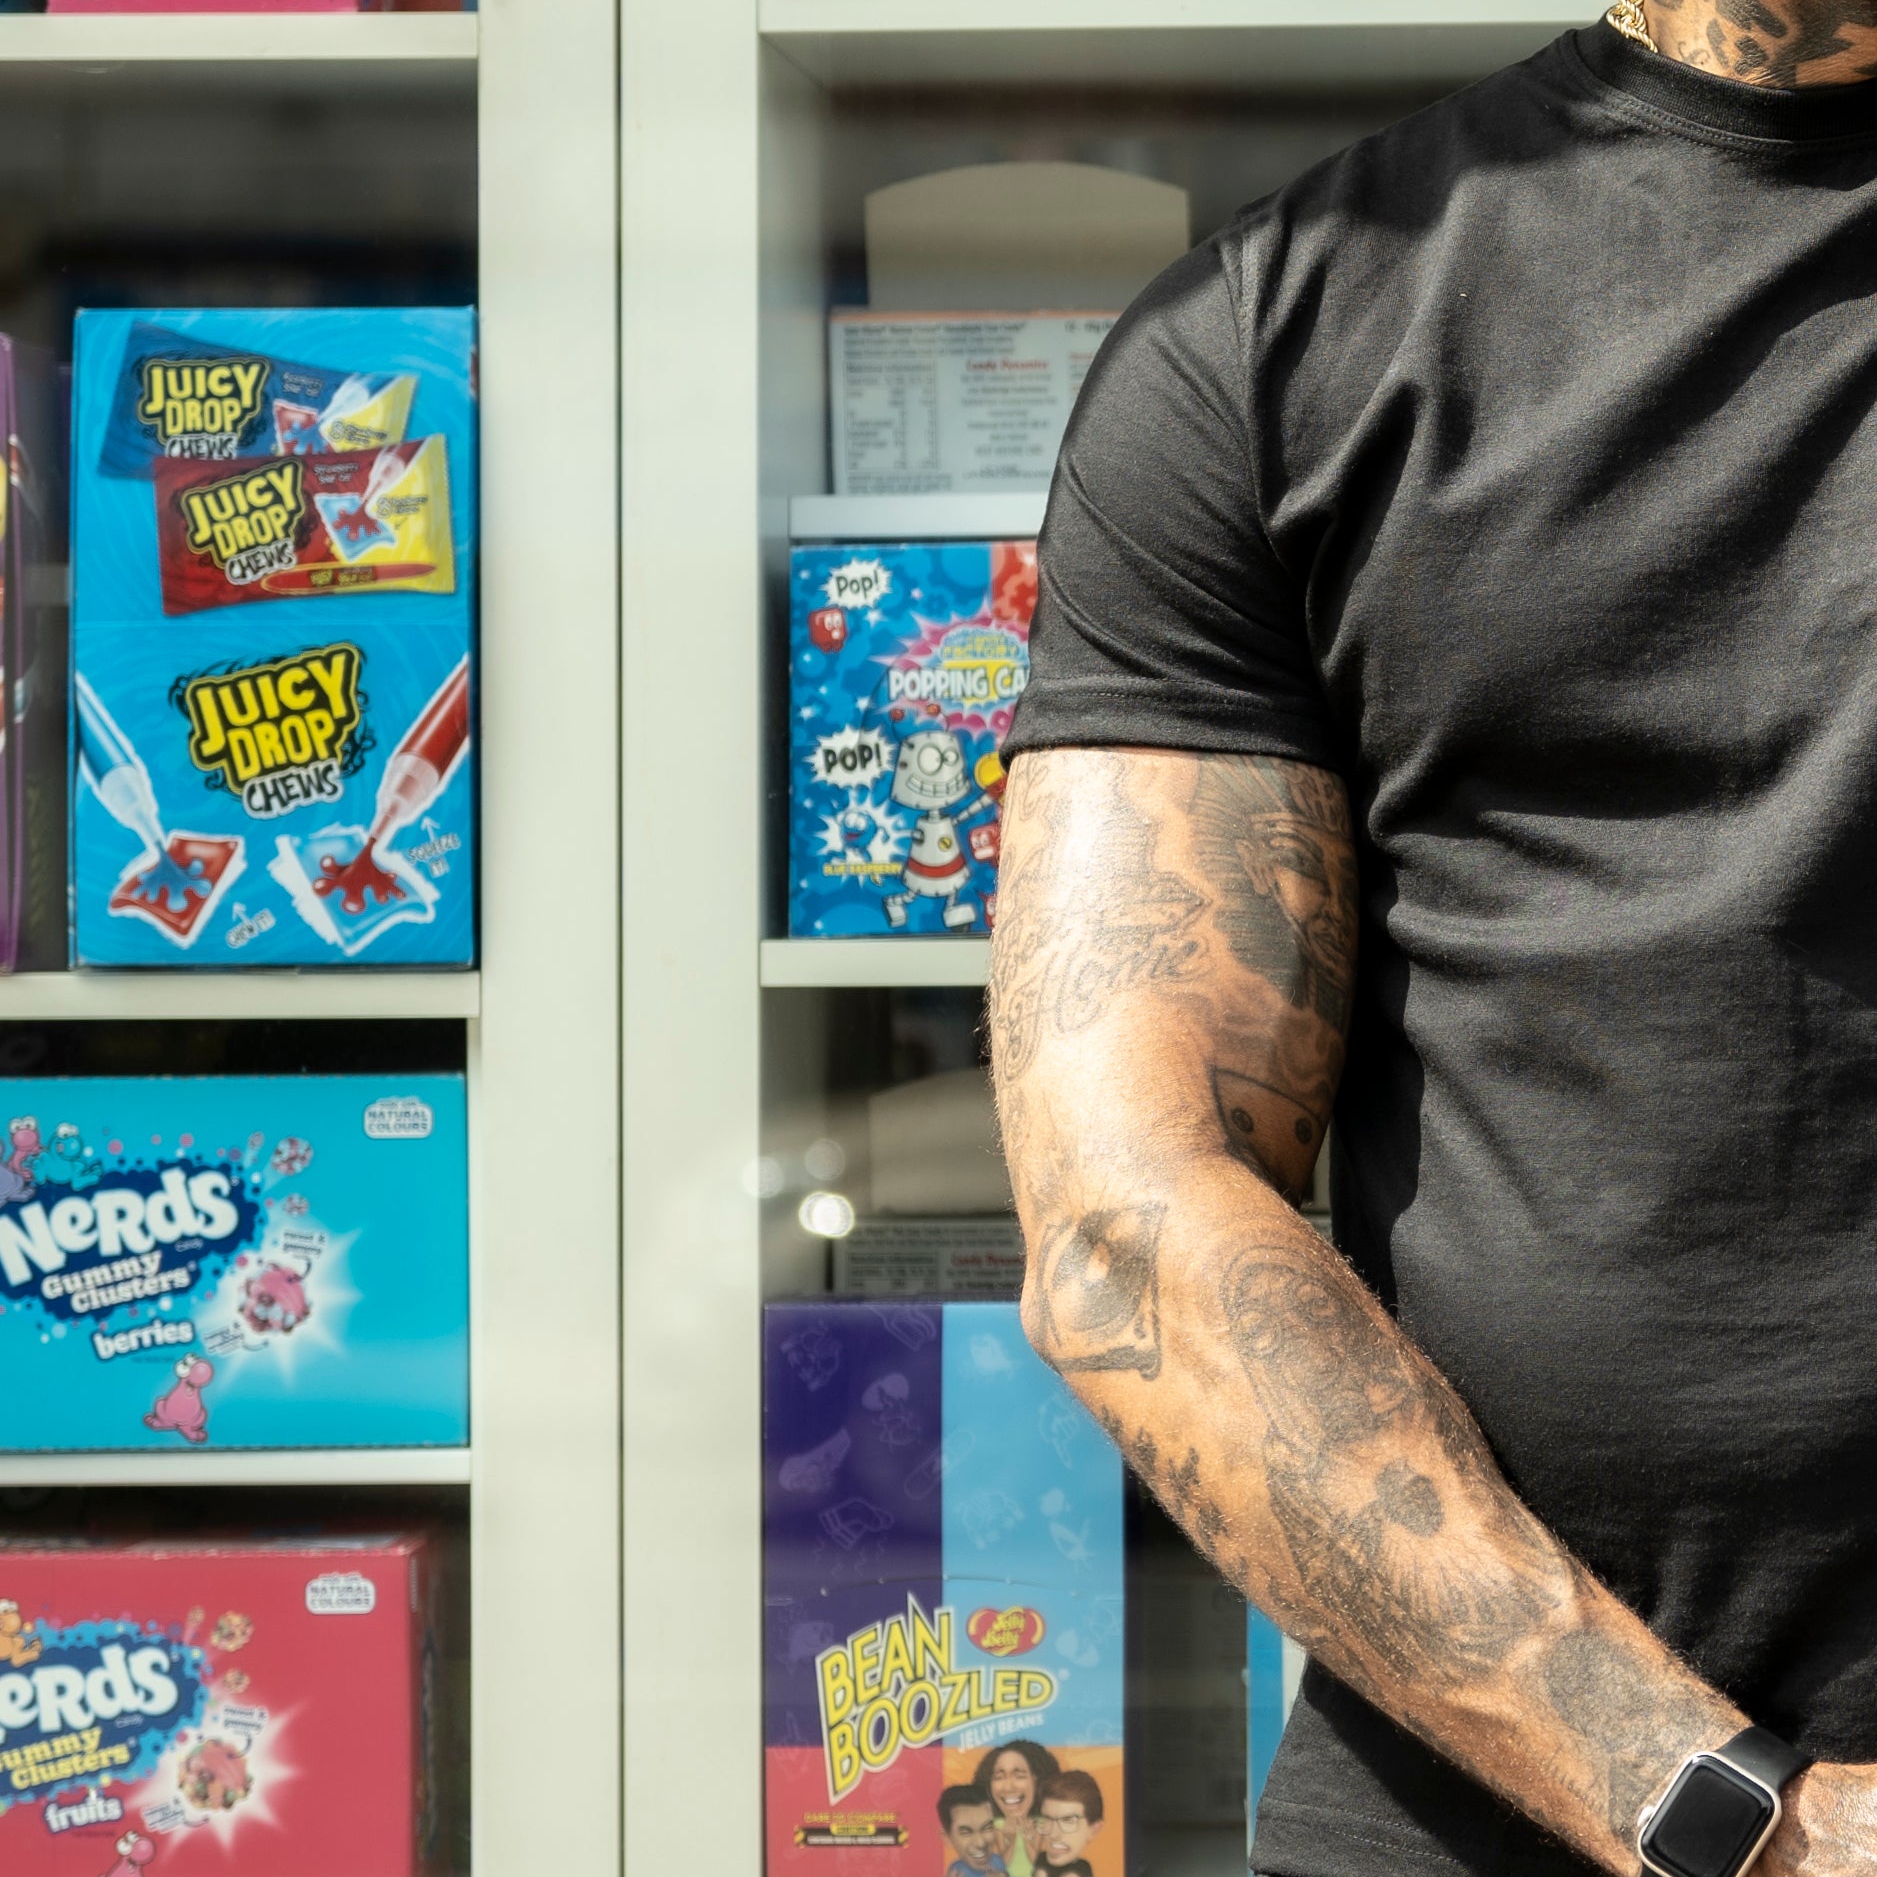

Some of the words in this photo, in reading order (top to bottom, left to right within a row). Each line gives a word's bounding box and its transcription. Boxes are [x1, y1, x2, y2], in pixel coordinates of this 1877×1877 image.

[145, 360, 267, 416] JUICY
[164, 398, 241, 439] DROP
[166, 434, 236, 458] CHEWS
[188, 462, 301, 544] JUICY
[214, 505, 290, 560] DROP
[226, 541, 295, 582] CHEWS
[835, 569, 880, 599] Pop!
[192, 650, 354, 757] JUICY
[888, 669, 989, 699] POPPING
[231, 709, 335, 786] DROP
[822, 742, 883, 773] POP!
[246, 766, 340, 815] CHEWS
[367, 1121, 428, 1133] COLOURS
[41, 1250, 162, 1300] Gummy
[94, 1320, 193, 1360] berries
[820, 1608, 952, 1727] BEAN
[829, 1670, 1054, 1795] BOOZLED
[958, 1726, 996, 1753] JELLY
[999, 1713, 1045, 1737] BEANS
[45, 1791, 123, 1833] fruits
